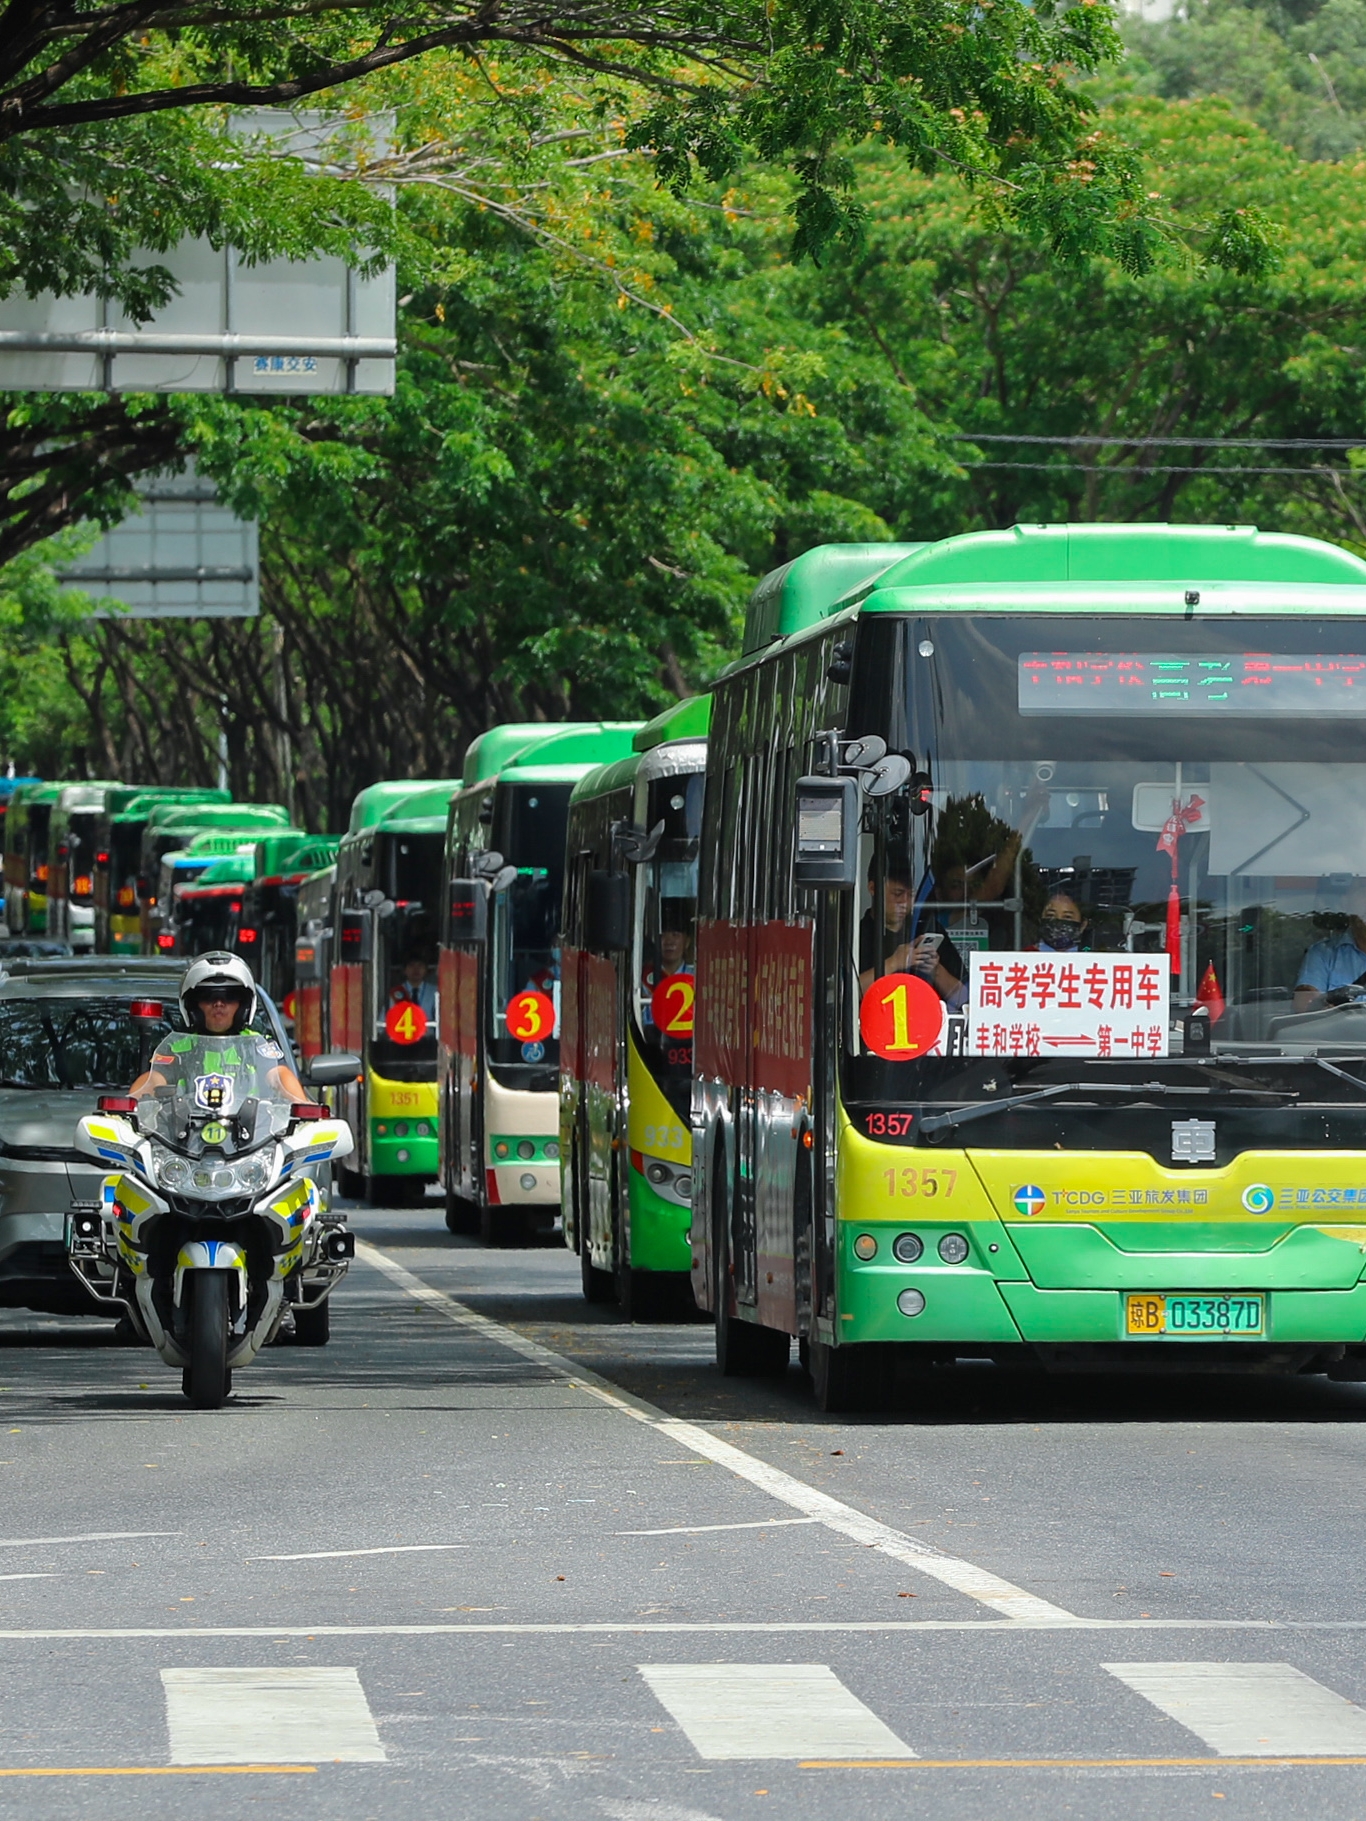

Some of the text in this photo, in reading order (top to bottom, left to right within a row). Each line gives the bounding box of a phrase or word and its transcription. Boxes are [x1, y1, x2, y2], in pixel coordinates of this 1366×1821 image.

[978, 961, 1160, 1011] 高考学生专用车
[516, 997, 541, 1038] 3
[665, 981, 695, 1032] 2
[881, 984, 919, 1051] 1
[394, 1006, 417, 1040] 4
[975, 1022, 1042, 1057] 丰和学校
[1096, 1024, 1163, 1057] 第一中学
[389, 1091, 420, 1106] 1351
[205, 1127, 222, 1140] 11
[643, 1124, 685, 1149] 933
[865, 1112, 914, 1136] 1357
[883, 1167, 958, 1198] 1357
[1112, 1189, 1208, 1205] 三亚旅发集团
